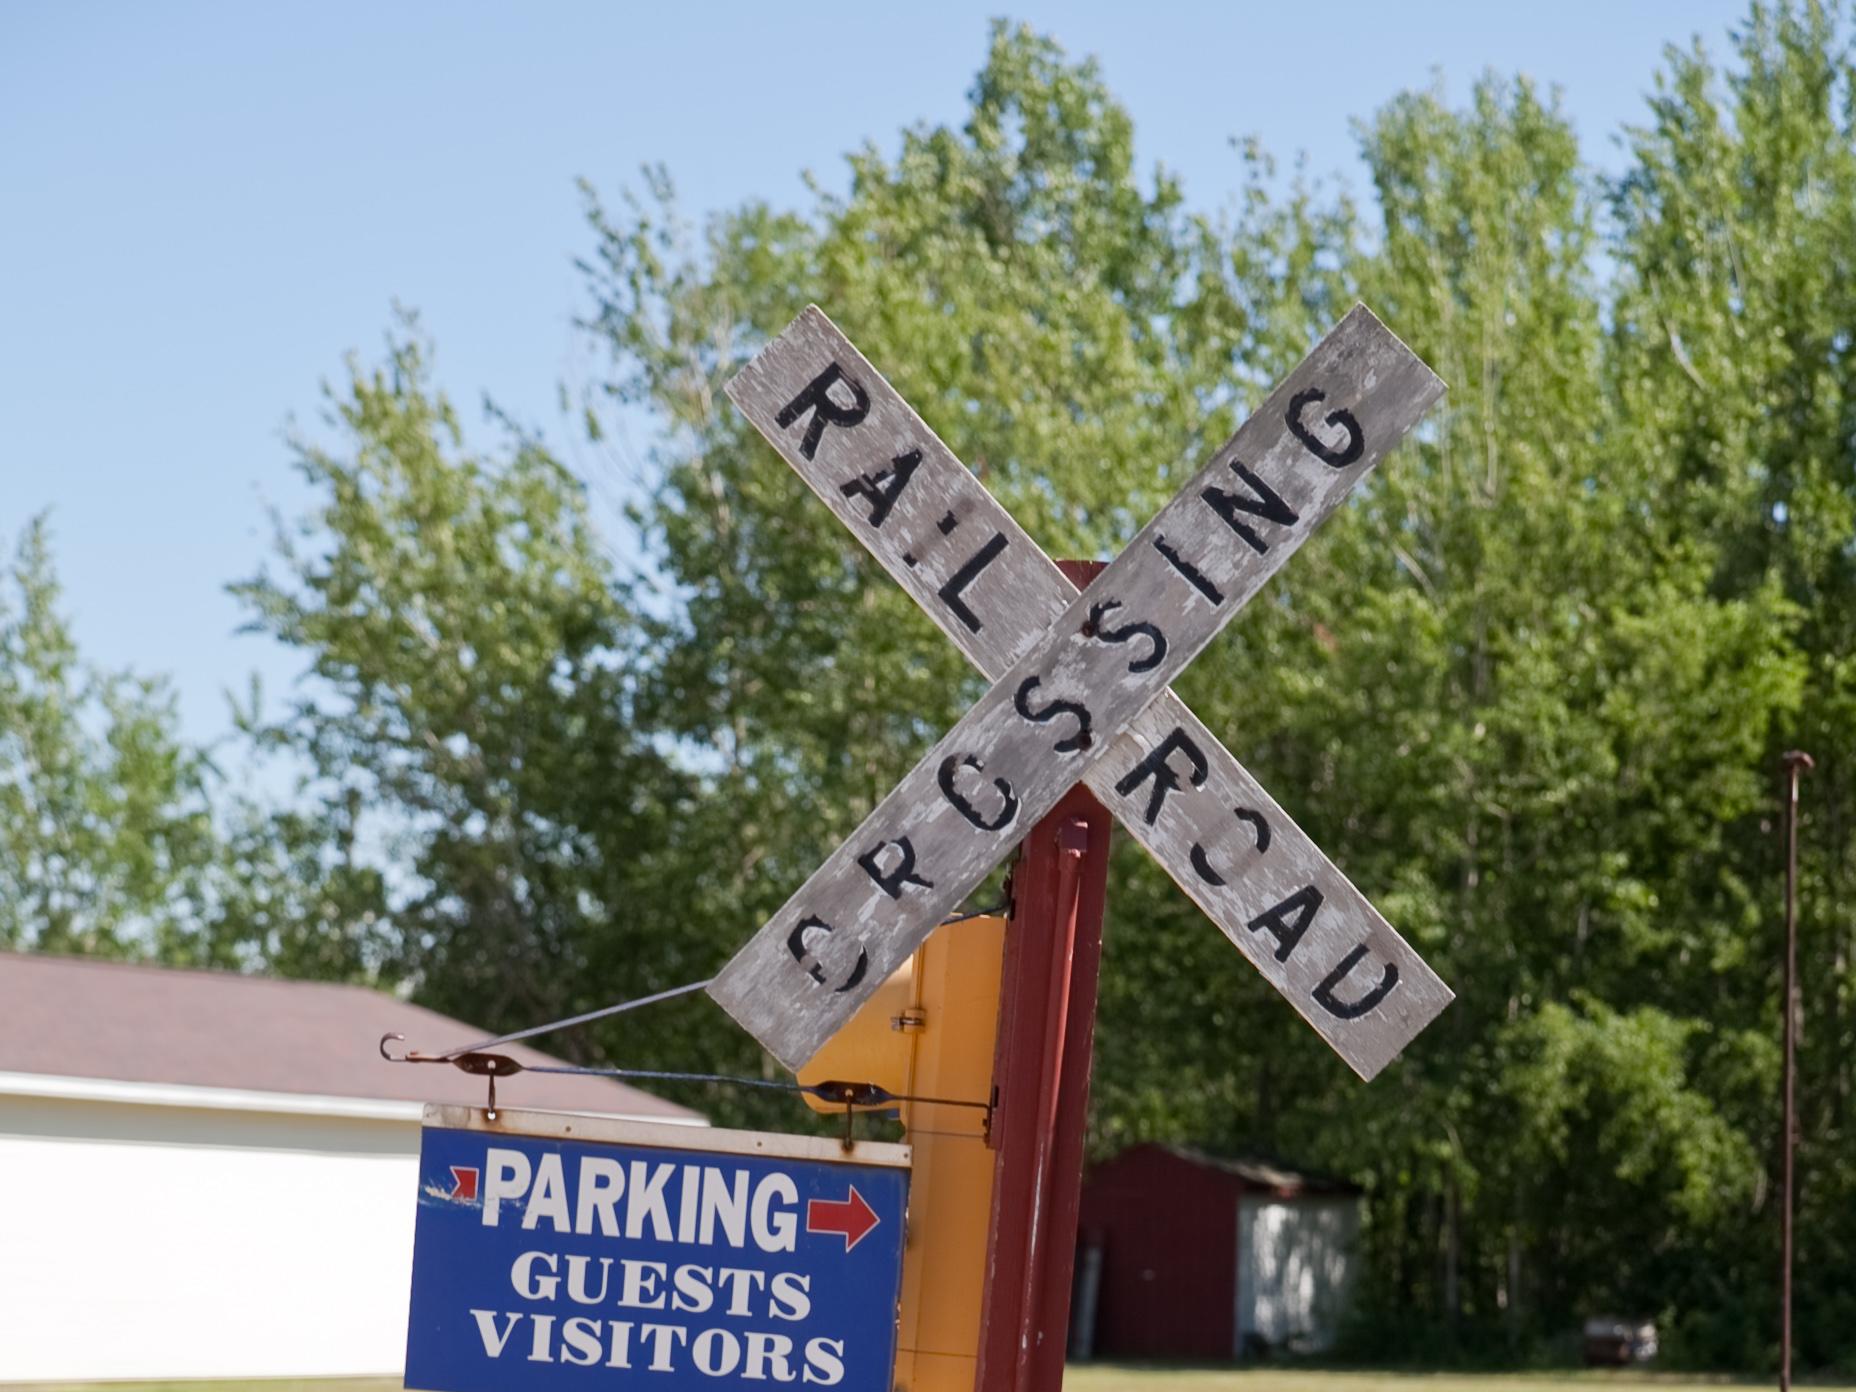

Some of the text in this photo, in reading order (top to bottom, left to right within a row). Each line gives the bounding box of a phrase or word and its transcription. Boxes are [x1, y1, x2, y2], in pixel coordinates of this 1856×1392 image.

[774, 362, 1400, 1020] RAIL ROAD
[787, 387, 1366, 993] CROSSING
[482, 1147, 799, 1253] PARKING
[511, 1250, 811, 1321] GUESTS
[470, 1308, 844, 1386] VISITORS
